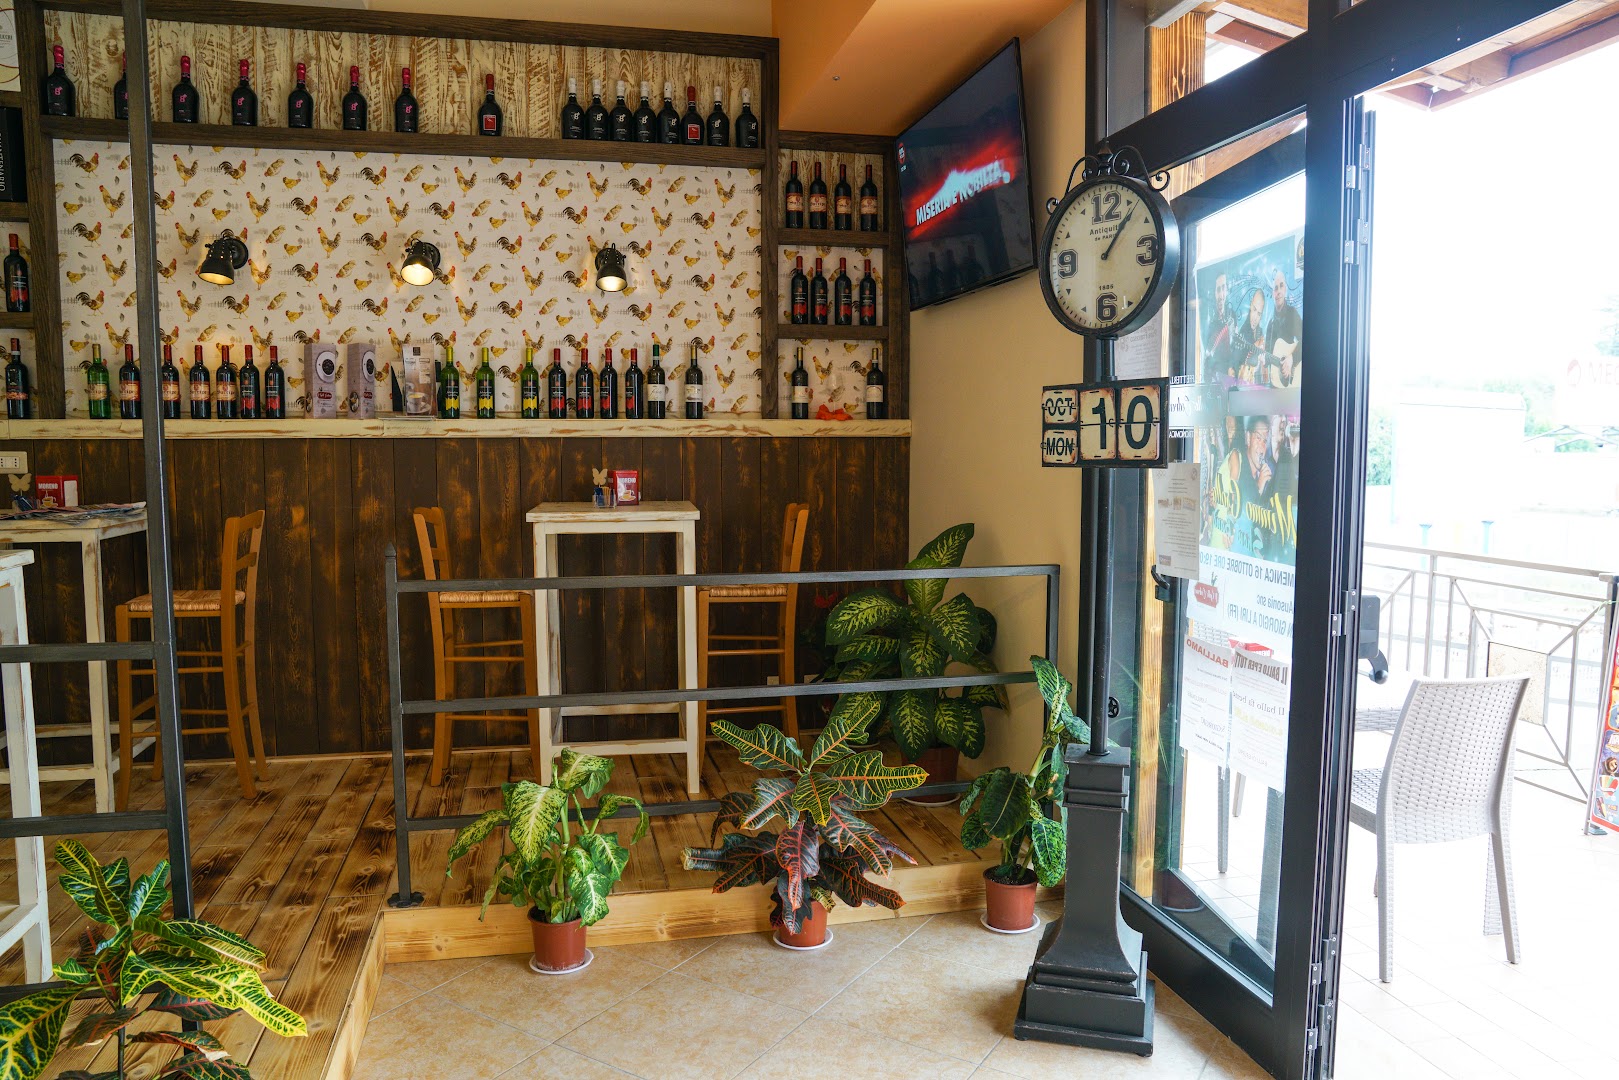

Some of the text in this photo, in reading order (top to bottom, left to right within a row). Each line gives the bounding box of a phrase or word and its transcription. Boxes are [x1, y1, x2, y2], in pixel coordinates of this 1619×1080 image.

[915, 194, 952, 226] MISERIA
[1090, 189, 1122, 225] 12
[1090, 224, 1119, 236] Antiquit
[1057, 248, 1079, 279] 9
[1136, 235, 1158, 266] 3
[1095, 291, 1118, 323] 6
[1046, 397, 1074, 417] OCT
[1046, 436, 1074, 457] MON
